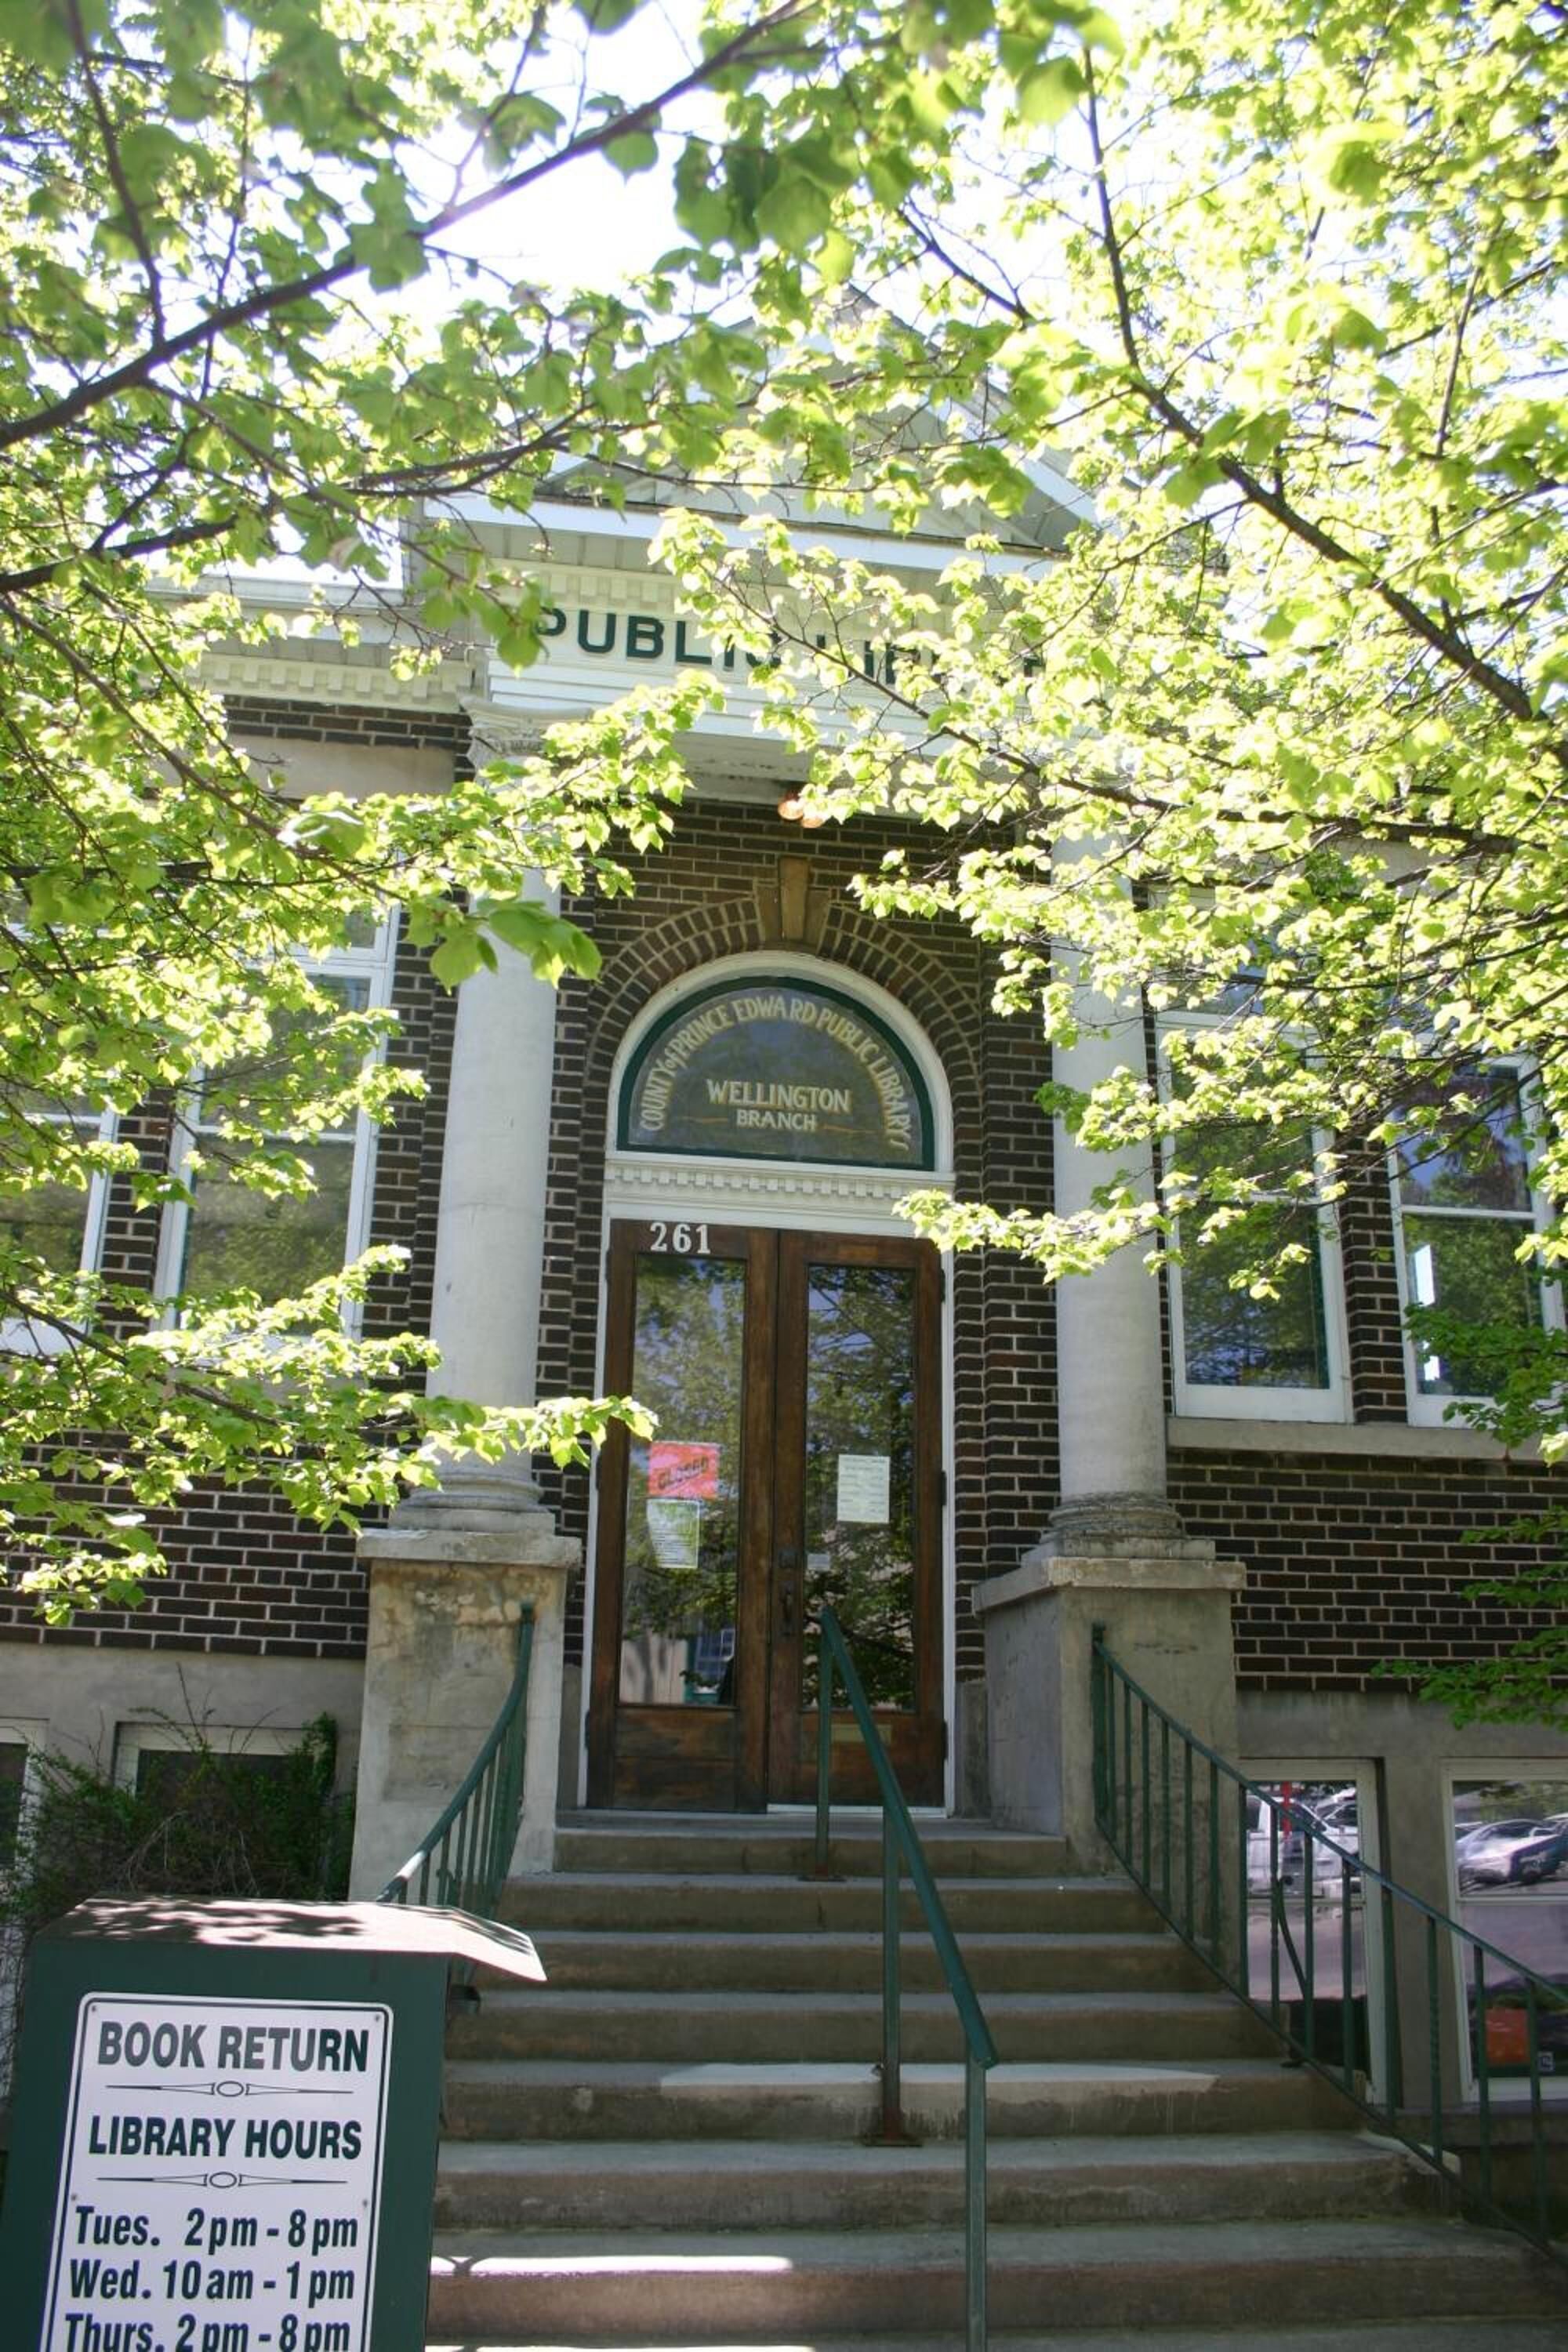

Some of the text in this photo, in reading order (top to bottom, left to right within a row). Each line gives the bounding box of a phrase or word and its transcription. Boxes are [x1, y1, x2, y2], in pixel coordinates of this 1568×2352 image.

[640, 1059, 676, 1131] COUNTY
[669, 1004, 733, 1058] PRINCE
[731, 995, 816, 1023] EDWARD
[815, 1007, 879, 1062] PUBLIC
[706, 1079, 851, 1113] WELLINGTON
[736, 1109, 816, 1132] BRANCH
[650, 1221, 711, 1254] 261
[98, 2021, 369, 2072] BOOK RETURN
[89, 2115, 362, 2159] LIBRARY HOURS
[76, 2205, 160, 2246] Tues.
[70, 2259, 151, 2299] Wed.
[65, 2313, 165, 2352] Thurs.
